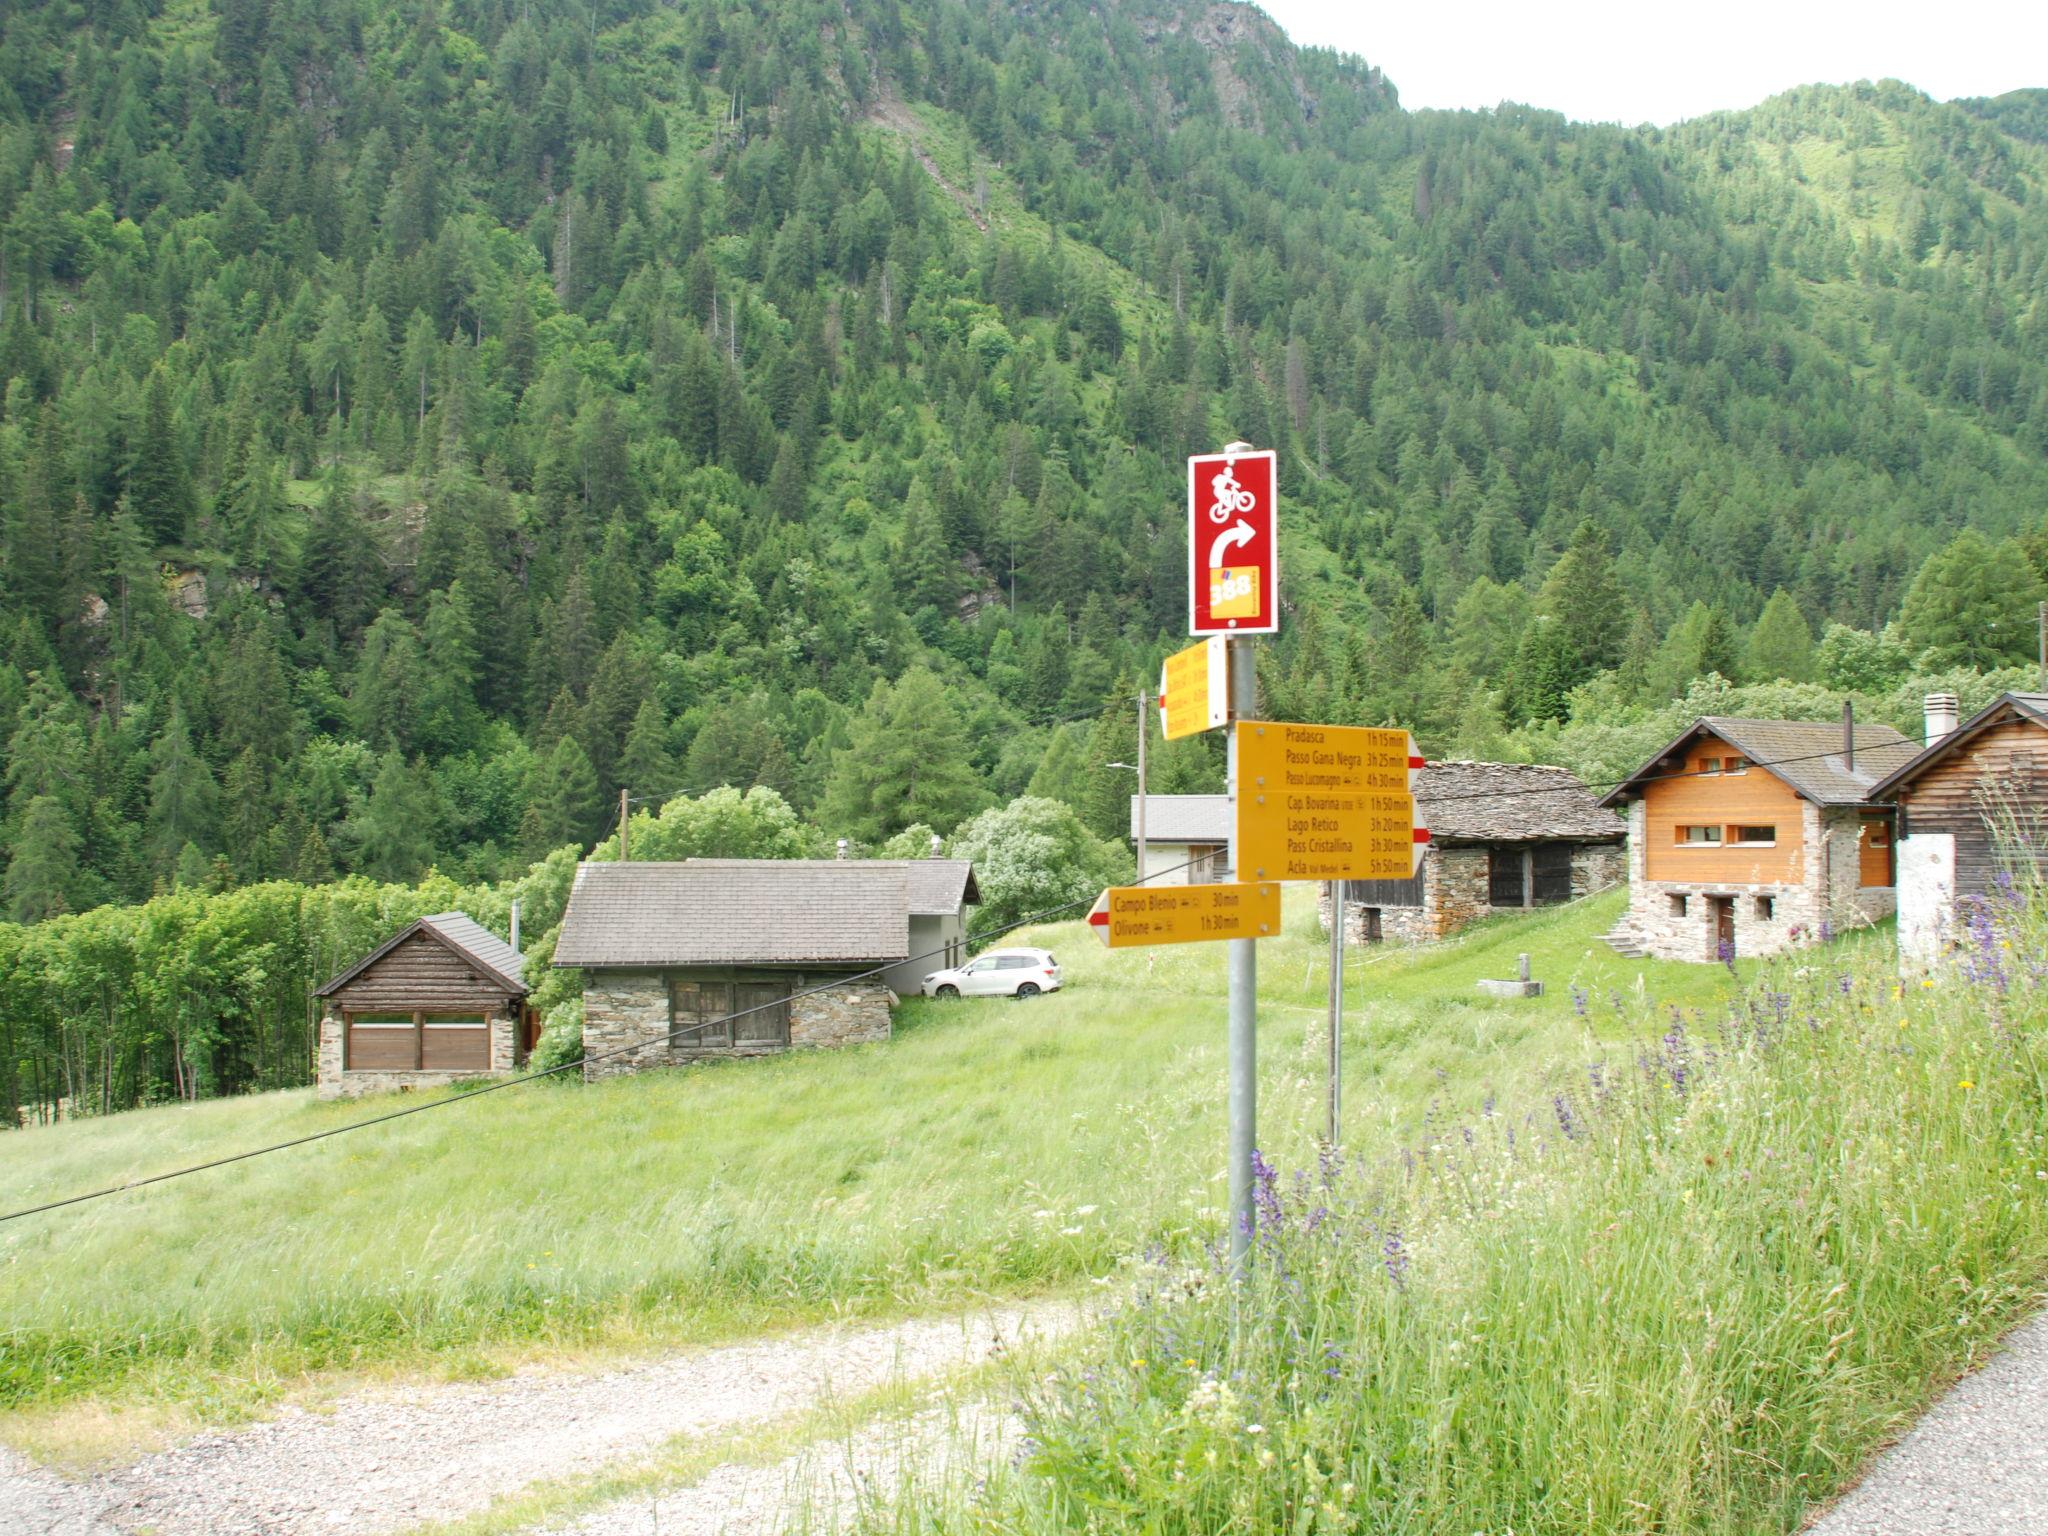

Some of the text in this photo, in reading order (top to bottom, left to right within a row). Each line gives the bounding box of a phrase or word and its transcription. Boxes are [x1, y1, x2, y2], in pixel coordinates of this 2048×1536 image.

[1286, 728, 1324, 744] Pradasca
[1286, 749, 1309, 764] Passo
[1312, 751, 1334, 765] Gana
[1337, 752, 1361, 769] Negra
[1286, 770, 1304, 785] Passo
[1305, 771, 1340, 790] Lucomagno
[1306, 796, 1339, 811] Bovarina
[1287, 817, 1309, 835] Lago
[1312, 817, 1339, 831] Retico
[1288, 839, 1306, 853] Pass
[1309, 839, 1353, 853] Cristallina
[1288, 860, 1307, 875] Acla
[1114, 896, 1146, 916] Campo
[1149, 895, 1177, 911] Blenio
[1114, 920, 1149, 936] Olivone
